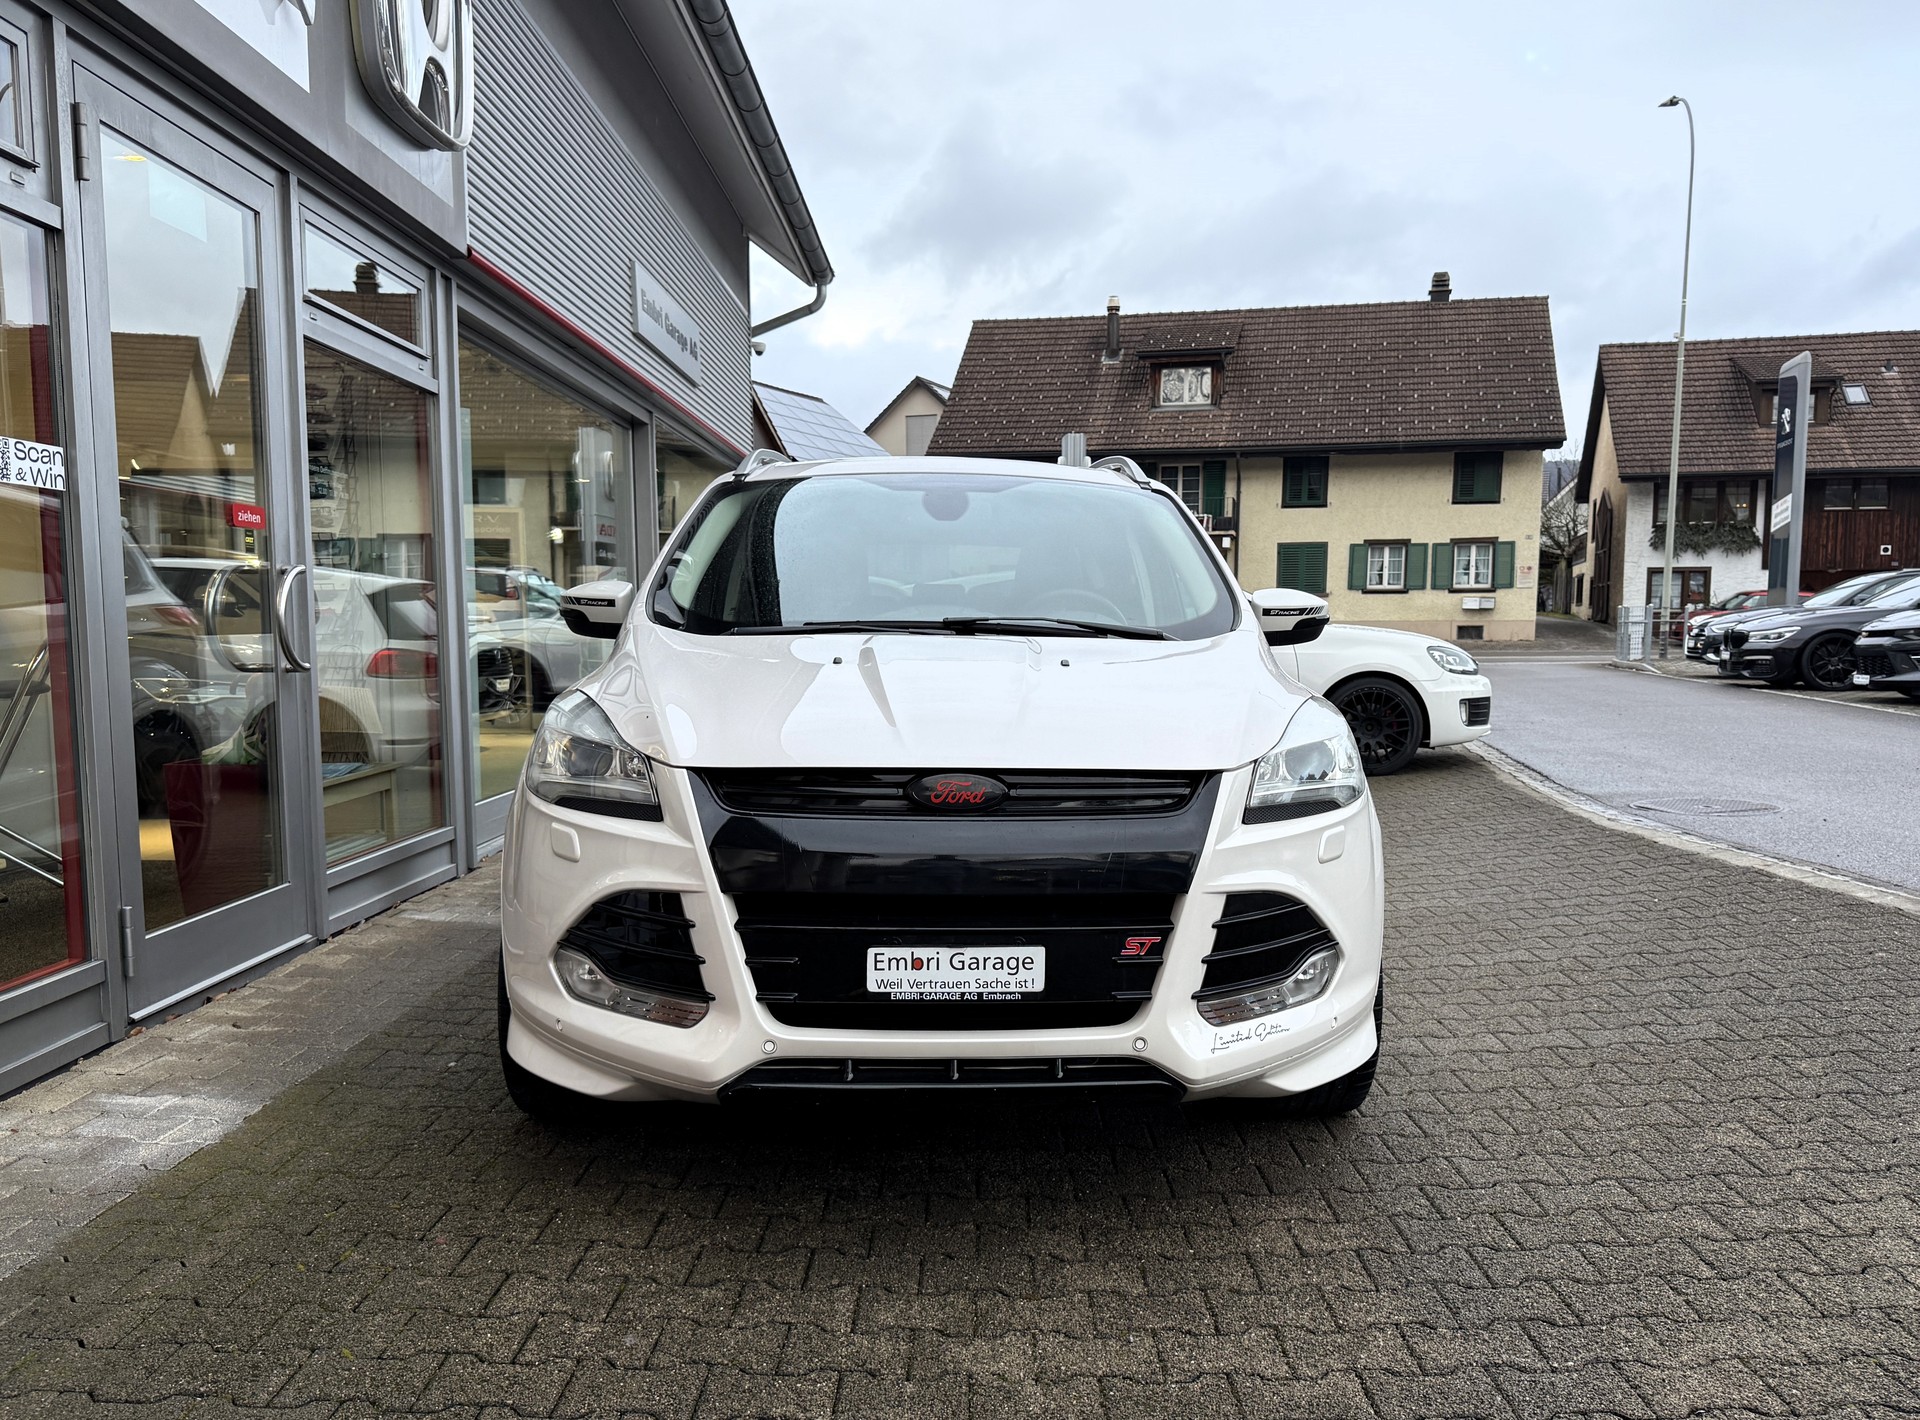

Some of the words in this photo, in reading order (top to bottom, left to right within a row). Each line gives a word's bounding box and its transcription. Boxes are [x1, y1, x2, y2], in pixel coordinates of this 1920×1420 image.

[14, 440, 64, 467] Scan
[15, 467, 27, 482] &
[29, 466, 66, 490] Win
[237, 510, 262, 524] ziehen
[930, 780, 987, 804] Ford
[1120, 936, 1162, 955] ST
[873, 951, 940, 971] Embri
[949, 952, 1035, 976] Garage
[875, 978, 903, 990] Weil
[907, 978, 971, 990] Vertrauen
[974, 978, 1011, 989] Sache
[890, 992, 962, 1001] EMBRI-GARAGE
[963, 992, 978, 1001] AG
[983, 992, 1022, 1001] Embrach
[1210, 1028, 1253, 1054] Limited
[1254, 1022, 1291, 1042] Edition
